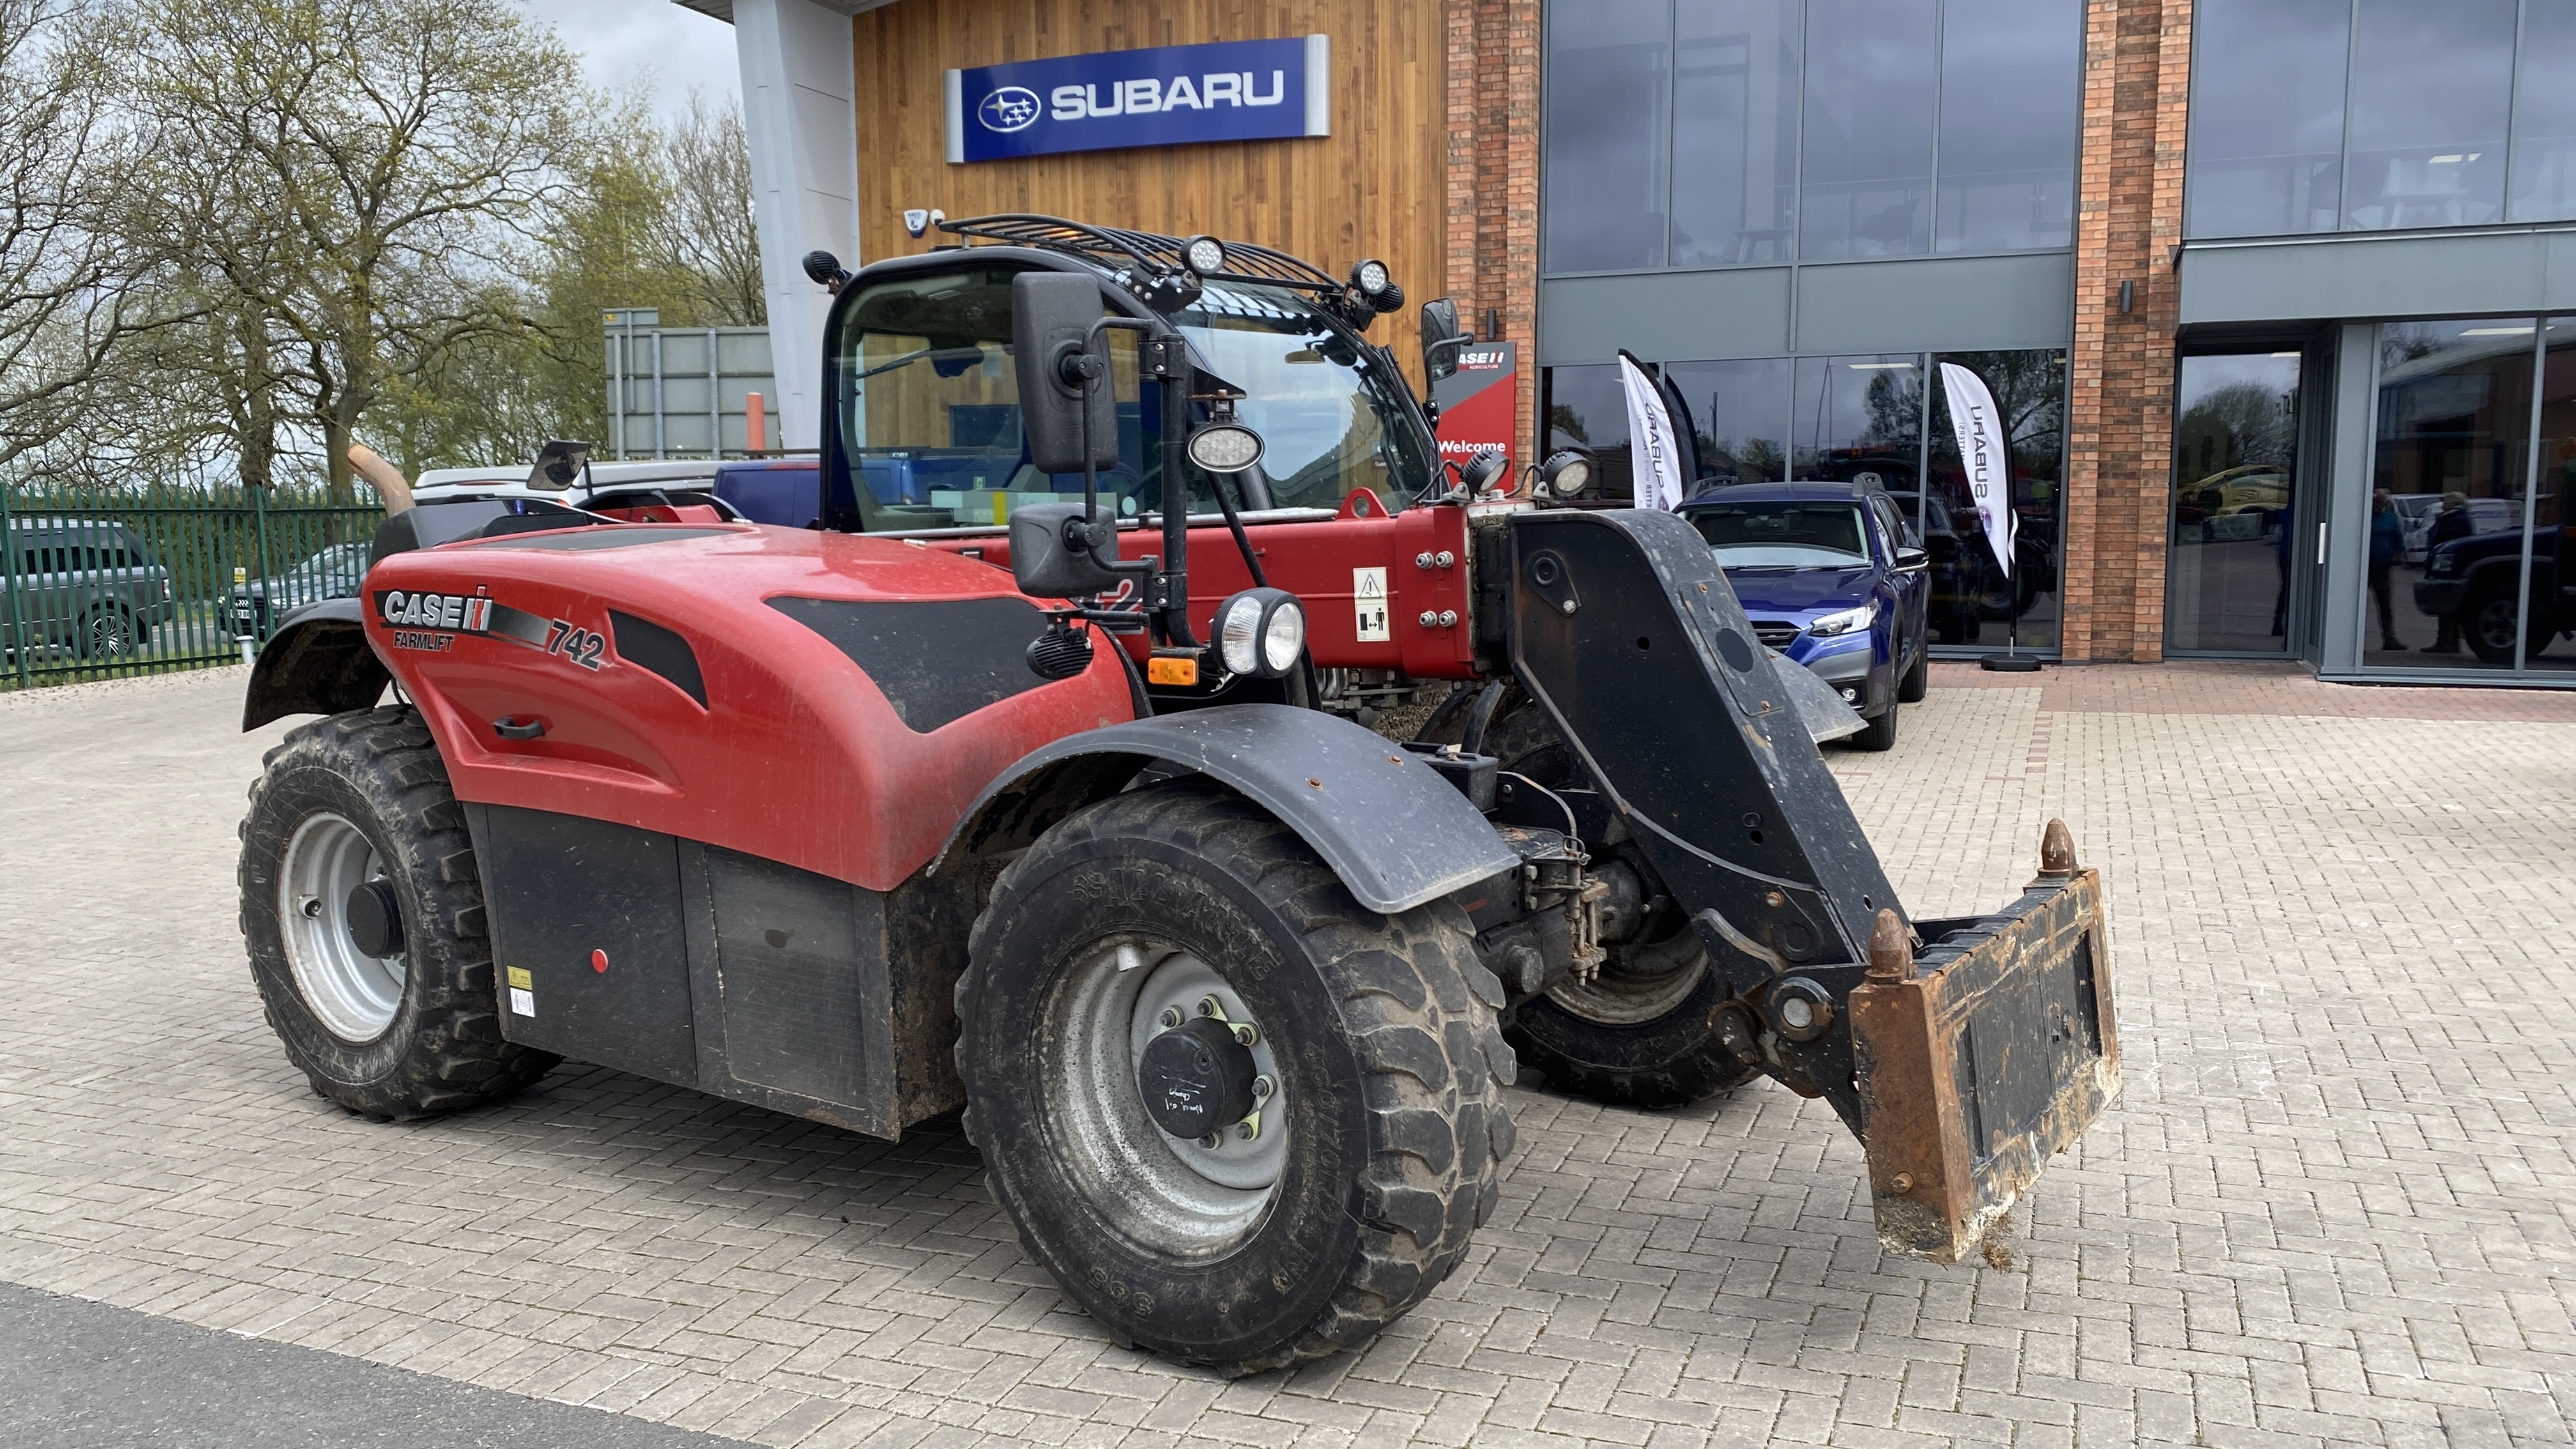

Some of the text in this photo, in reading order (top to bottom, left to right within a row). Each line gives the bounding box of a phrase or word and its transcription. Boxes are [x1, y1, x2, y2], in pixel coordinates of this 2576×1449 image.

[1050, 69, 1284, 121] SUBARU
[1458, 352, 1489, 364] ASE
[1438, 440, 1506, 454] Welcome
[384, 590, 463, 629] CASE
[392, 631, 455, 653] FARMLIFT
[548, 617, 606, 672] 742
